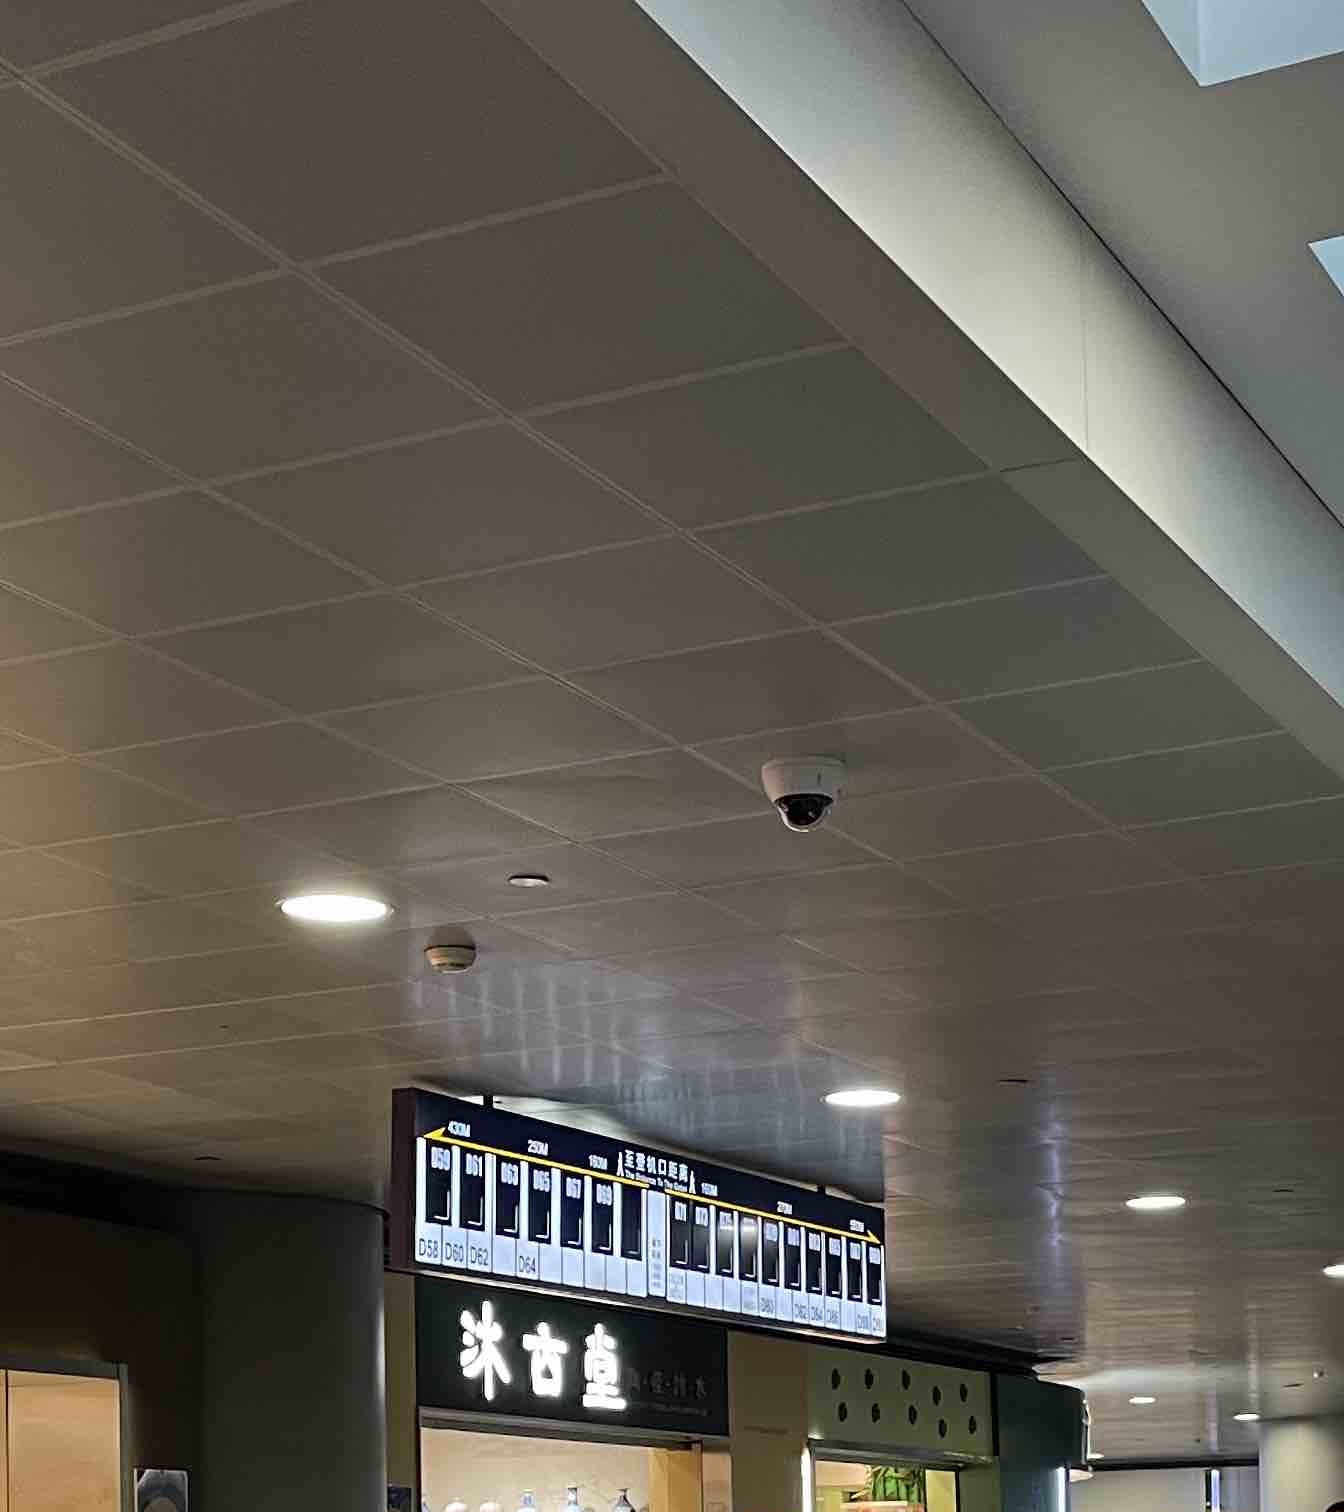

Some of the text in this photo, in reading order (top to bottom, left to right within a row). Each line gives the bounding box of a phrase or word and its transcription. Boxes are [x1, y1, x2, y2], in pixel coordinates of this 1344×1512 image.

[418, 1238, 537, 1274] D58 D60 D62 D64
